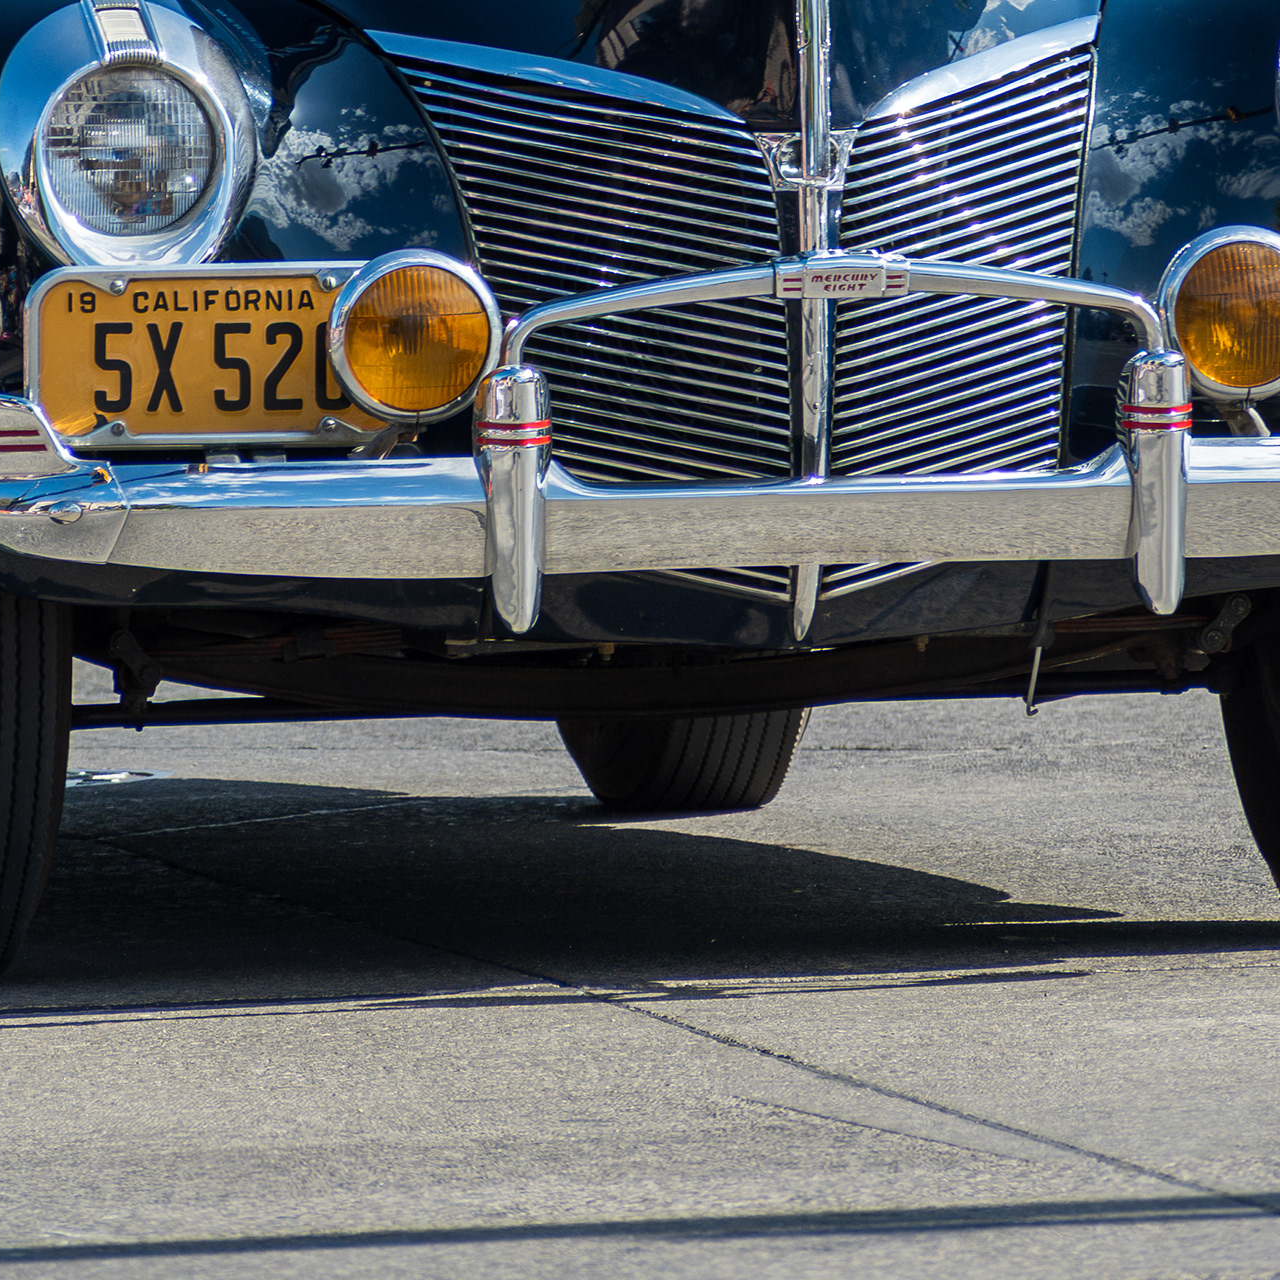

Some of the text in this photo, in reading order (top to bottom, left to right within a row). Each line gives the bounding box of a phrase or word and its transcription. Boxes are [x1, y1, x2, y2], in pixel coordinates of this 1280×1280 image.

[810, 273, 878, 283] MERCURY
[823, 283, 867, 292] EIGHT
[67, 289, 315, 314] 19 CALIFORNIA
[94, 321, 183, 413] 5X
